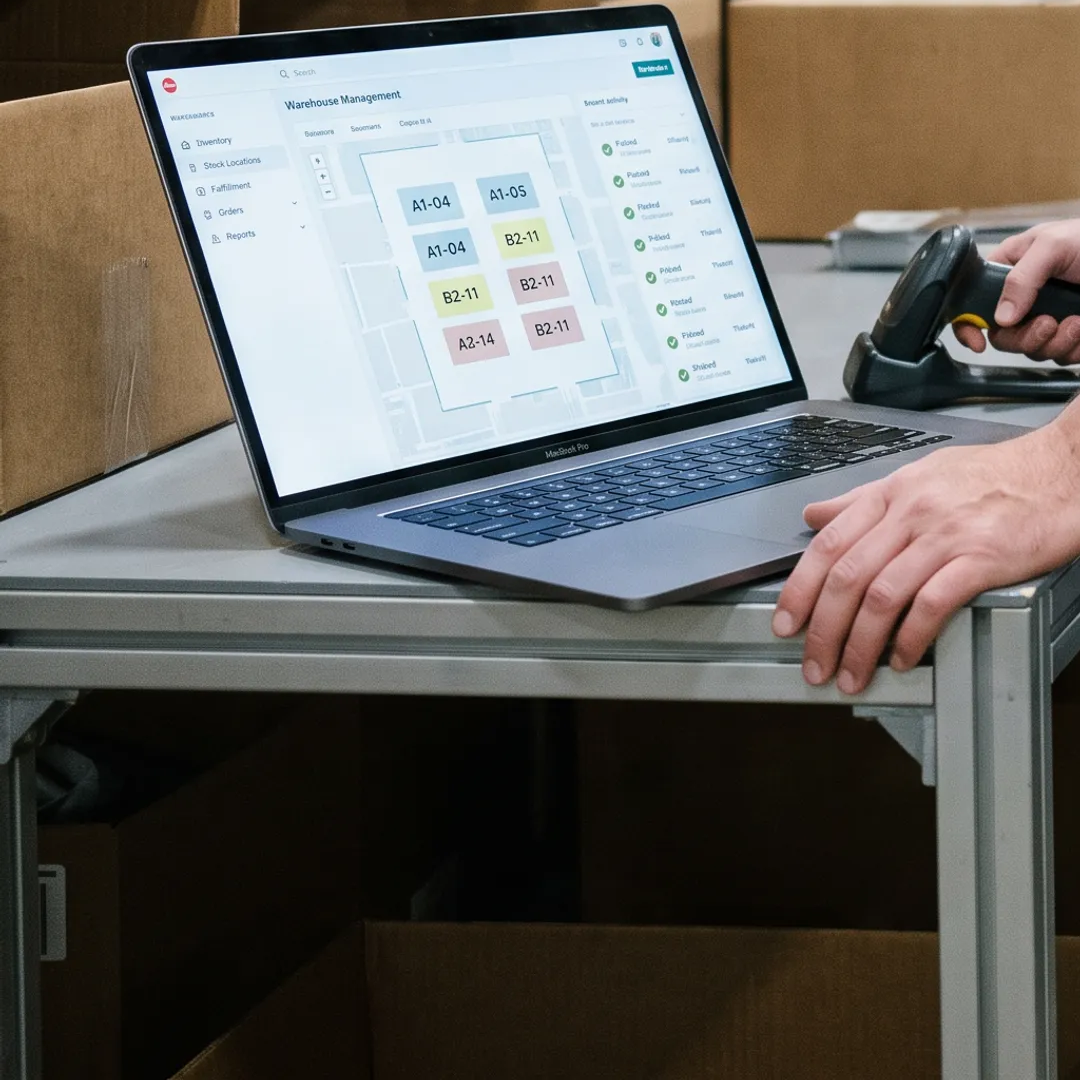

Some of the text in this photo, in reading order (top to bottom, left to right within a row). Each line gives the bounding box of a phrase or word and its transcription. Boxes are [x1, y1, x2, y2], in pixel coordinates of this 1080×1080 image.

[284, 89, 402, 111] Warehouse Management
[226, 156, 262, 167] Locations
[489, 184, 527, 202] A1-05
[411, 195, 452, 212] A1-04
[226, 230, 256, 241] Reports
[504, 229, 540, 246] B2-11
[427, 240, 467, 259] A1-04
[519, 274, 556, 291] B2-11
[441, 287, 480, 304] B2-11
[534, 319, 571, 337] B2-11
[545, 442, 590, 459] MacBook Pro
